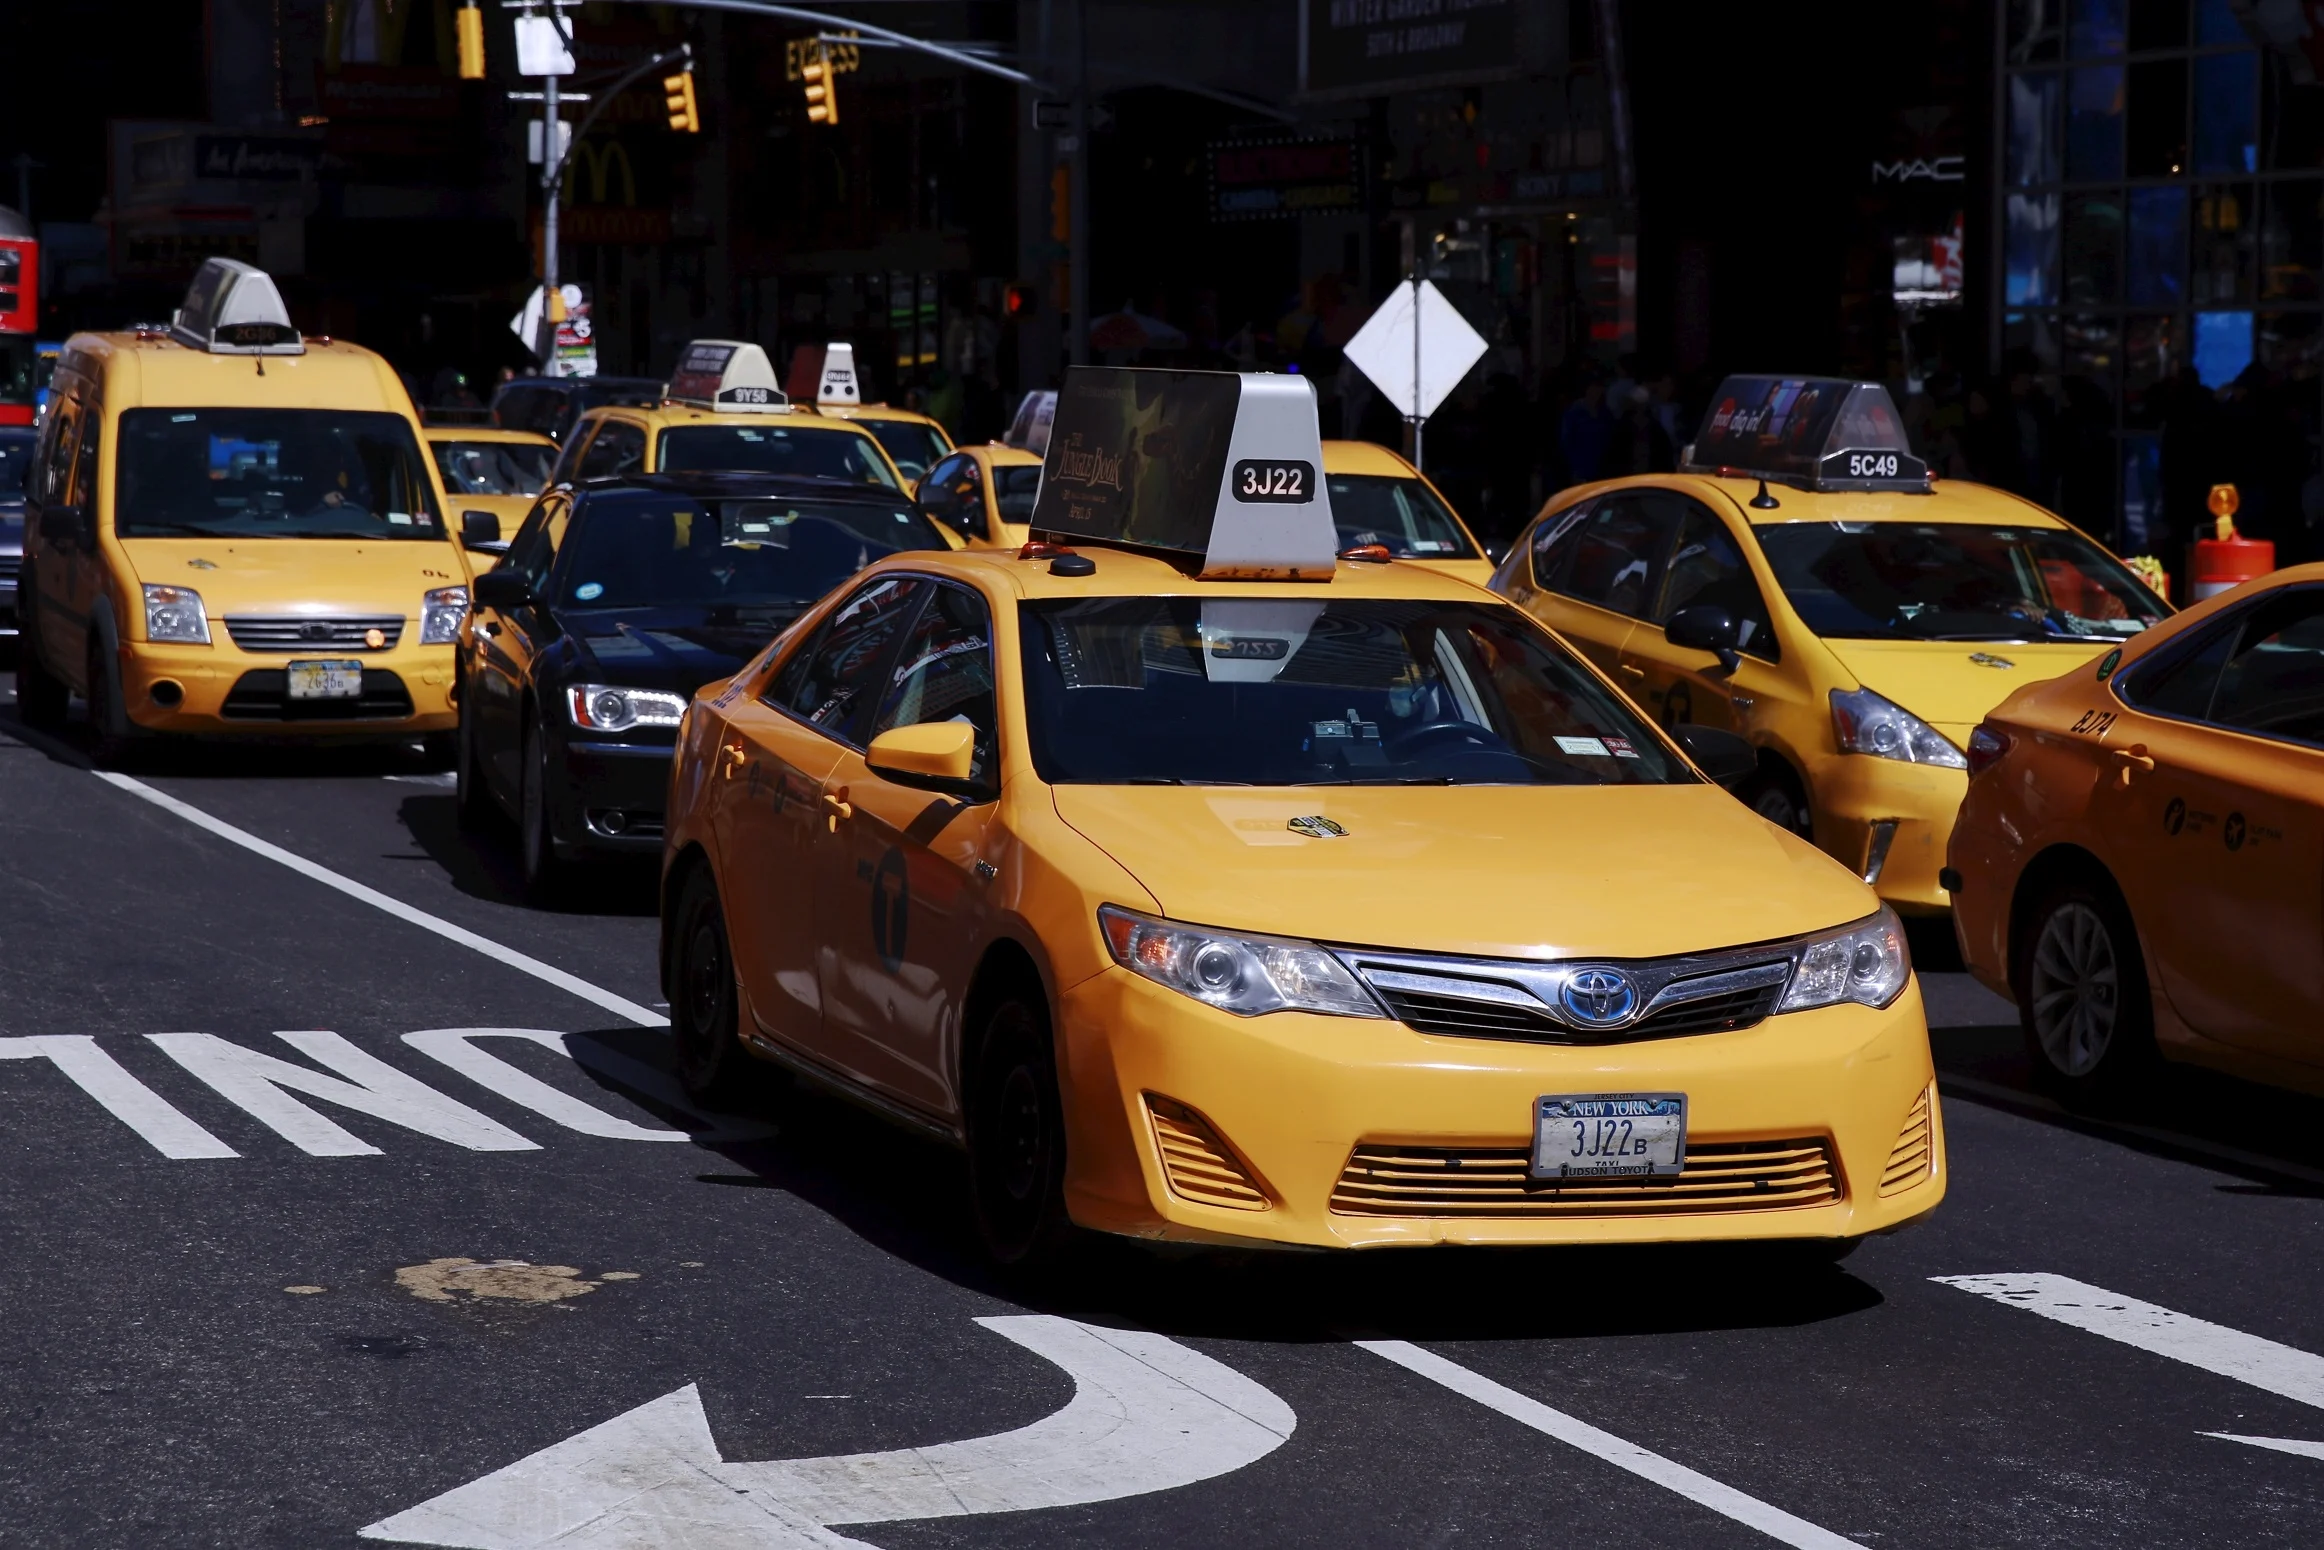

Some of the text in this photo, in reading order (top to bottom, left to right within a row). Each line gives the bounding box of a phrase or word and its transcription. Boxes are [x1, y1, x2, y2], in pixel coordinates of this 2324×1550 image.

[734, 388, 768, 403] 9Y58
[1850, 454, 1898, 477] 5C49
[1243, 466, 1303, 496] 3J22
[1619, 1092, 1635, 1100] CITY
[1573, 1100, 1650, 1116] NEW YORK
[1611, 1165, 1656, 1175] TOYOTA
